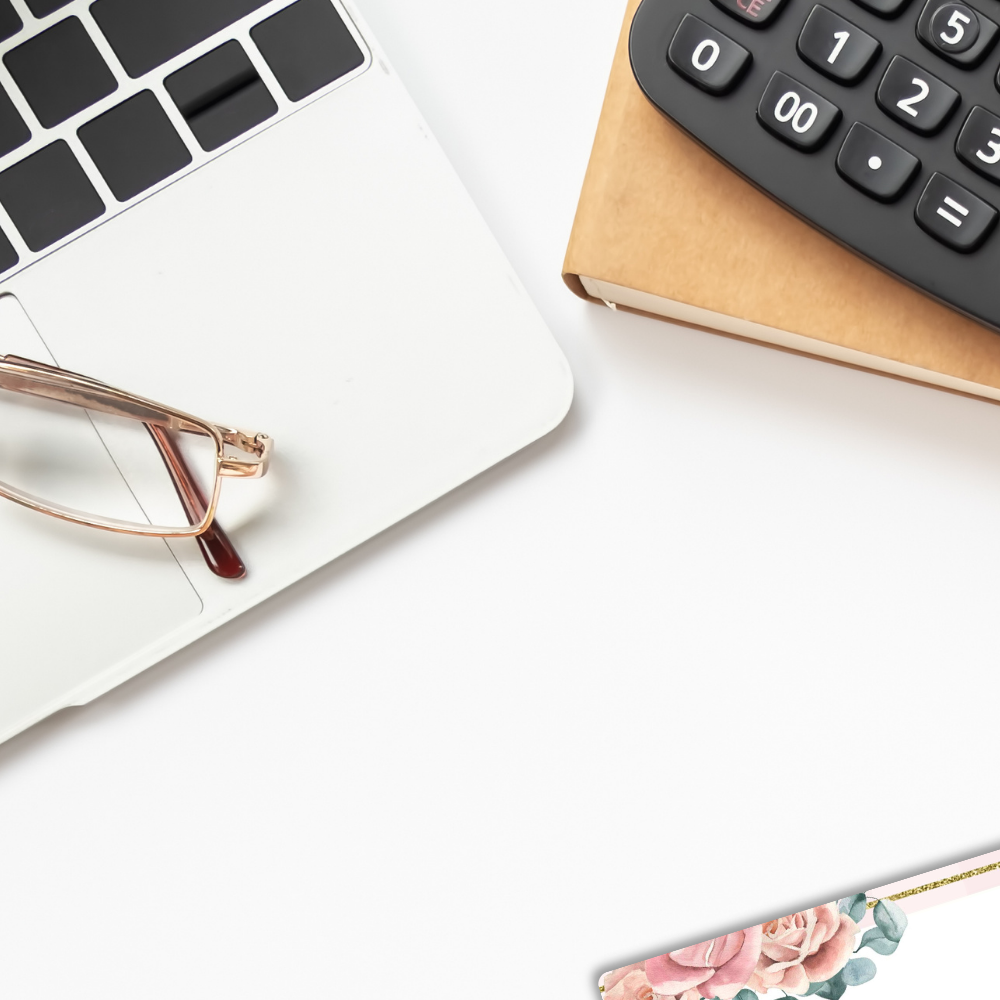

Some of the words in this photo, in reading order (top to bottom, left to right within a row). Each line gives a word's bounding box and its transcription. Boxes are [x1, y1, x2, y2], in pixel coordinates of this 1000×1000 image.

[940, 9, 971, 45] 5
[691, 38, 721, 72] 0
[827, 30, 851, 64] 1
[773, 91, 818, 134] 00
[896, 77, 930, 118] 2
